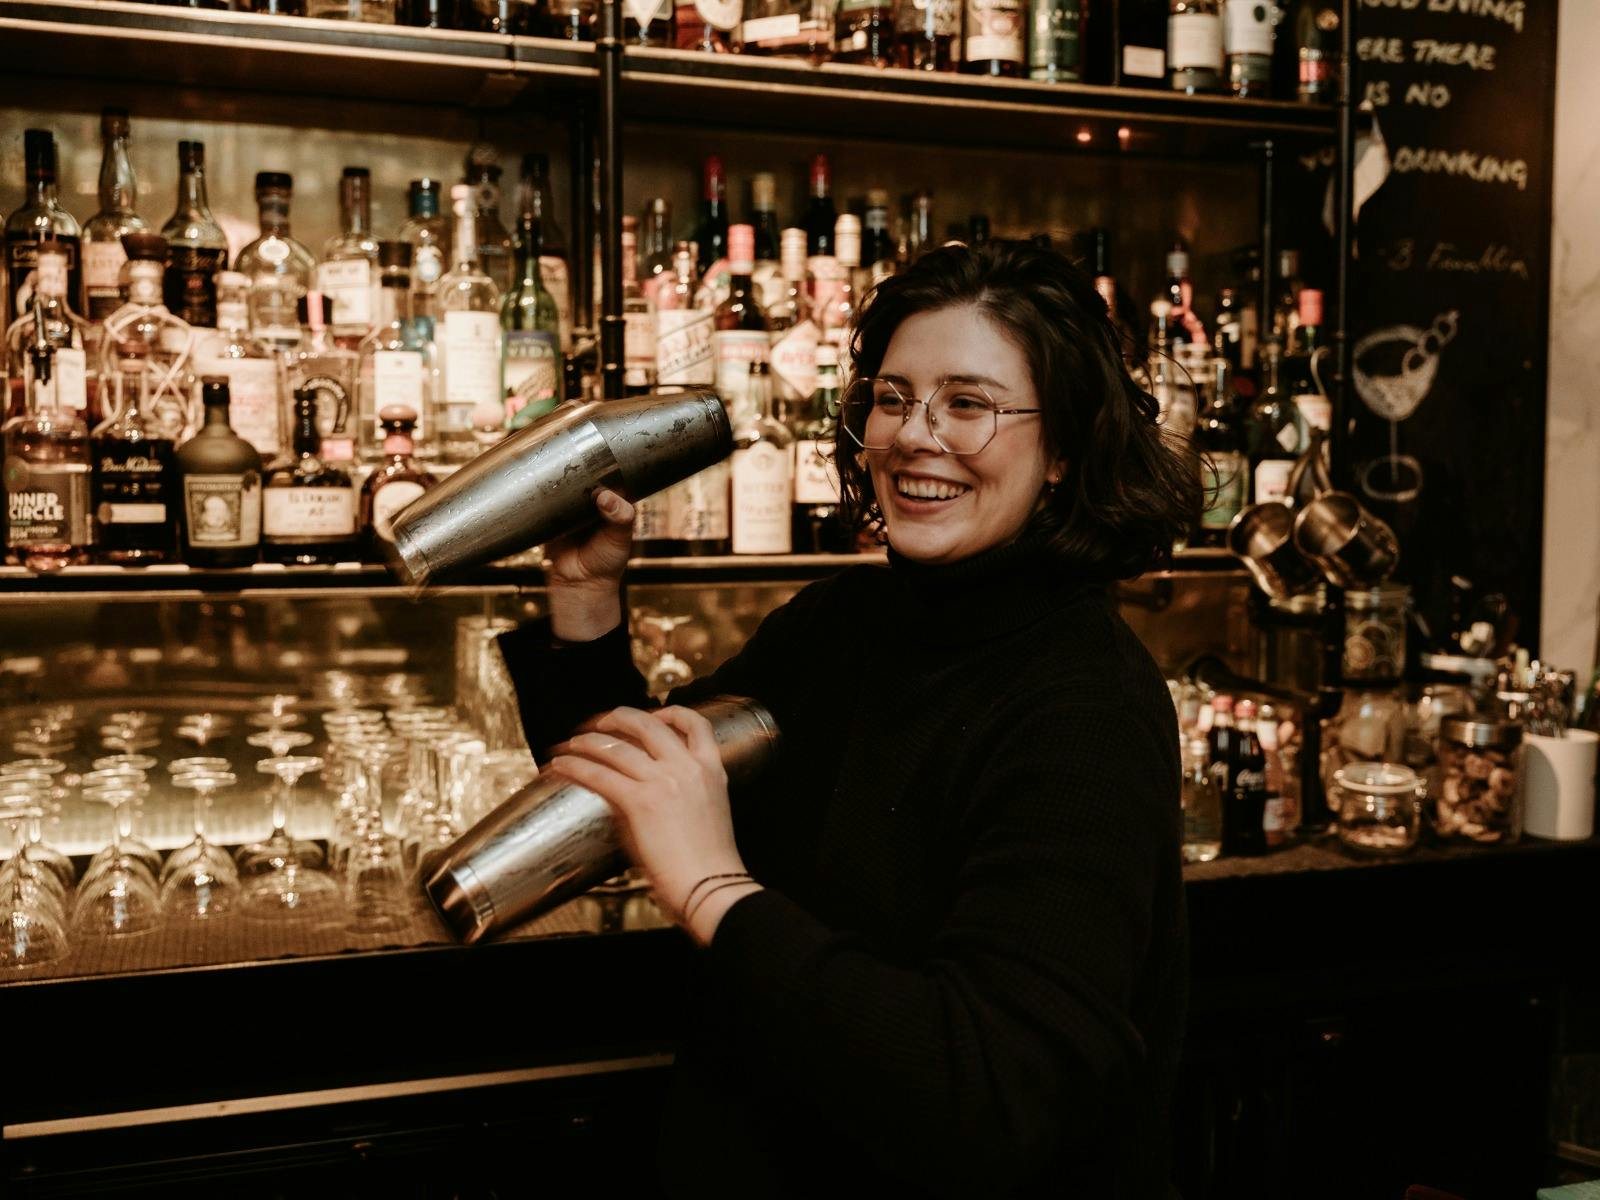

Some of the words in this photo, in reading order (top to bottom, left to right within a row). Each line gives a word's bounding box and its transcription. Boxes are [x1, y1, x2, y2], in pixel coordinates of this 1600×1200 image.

[1412, 39, 1497, 71] THERE
[1364, 80, 1391, 106] IS
[1404, 82, 1451, 108] NO
[1394, 147, 1528, 191] DRINKING
[9, 492, 58, 507] INNER
[9, 505, 65, 521] CIRCLE
